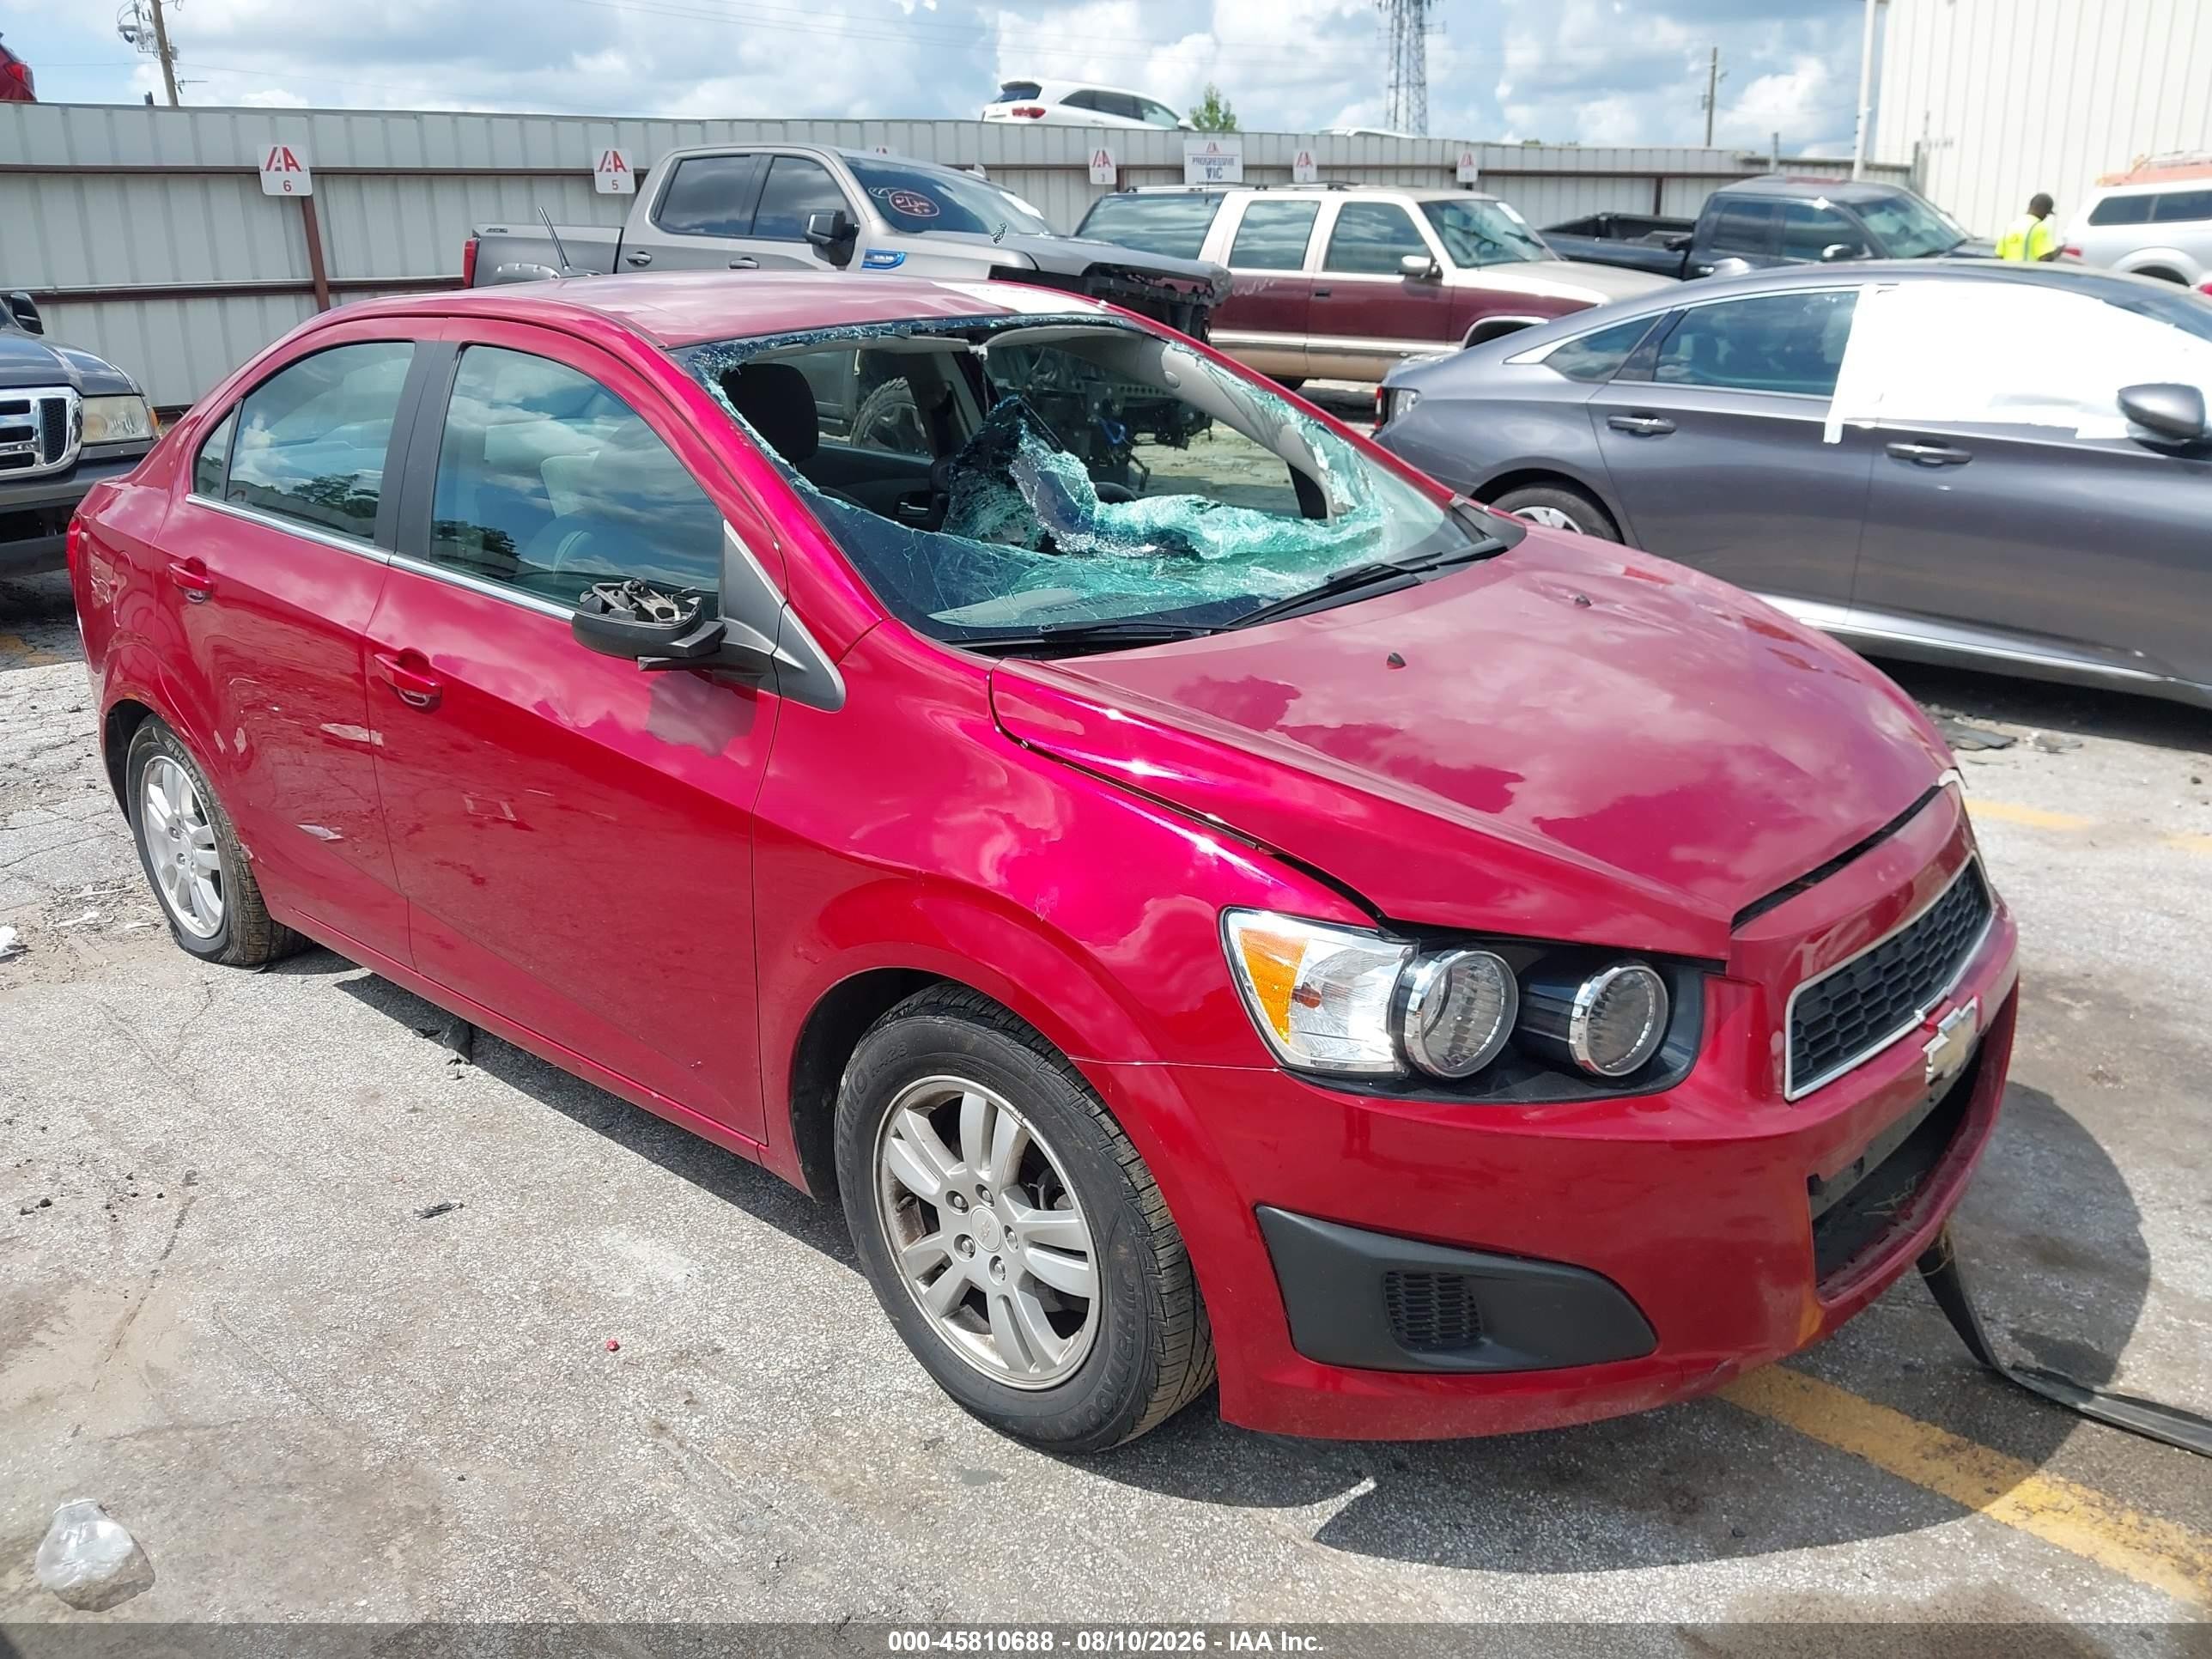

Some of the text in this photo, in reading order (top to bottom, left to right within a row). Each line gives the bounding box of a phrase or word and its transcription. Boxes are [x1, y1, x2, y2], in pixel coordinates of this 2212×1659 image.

[1205, 167, 1223, 179] VIC
[283, 179, 292, 192] 6
[611, 179, 619, 191] 5
